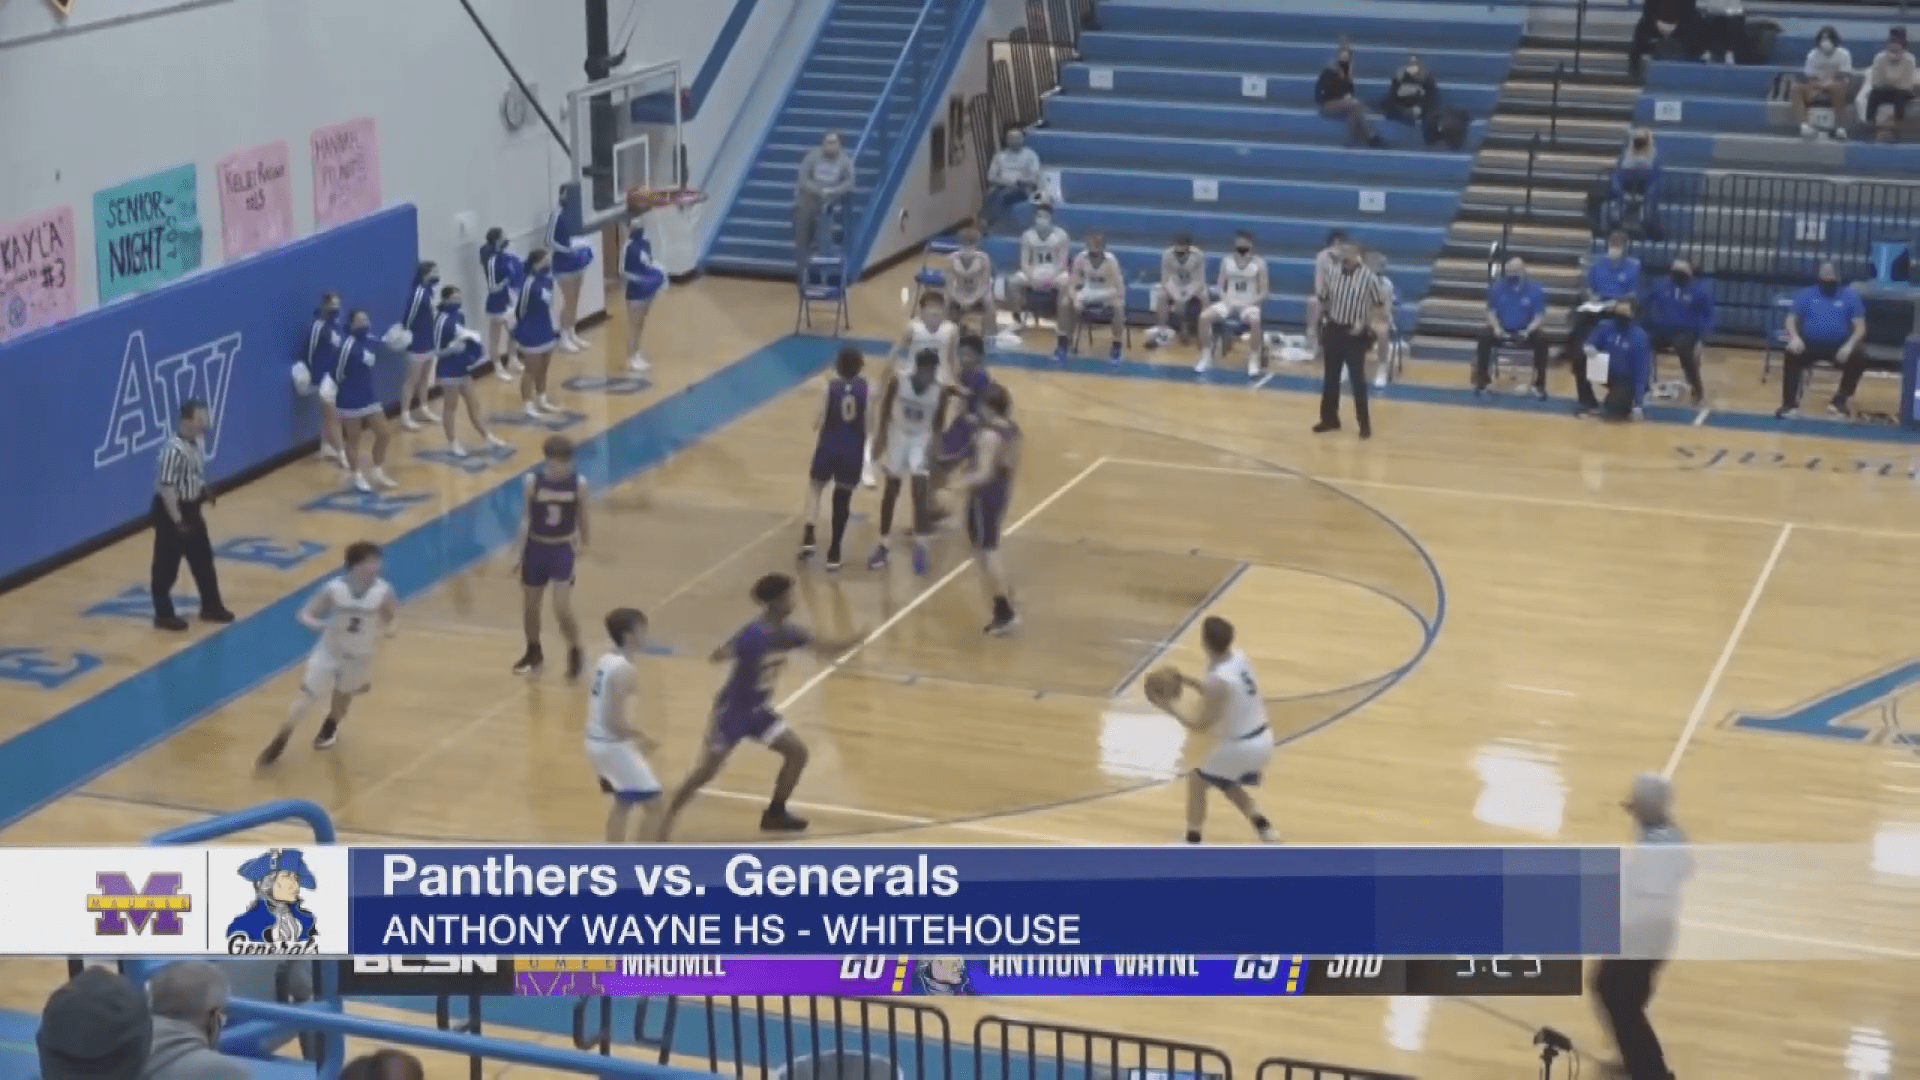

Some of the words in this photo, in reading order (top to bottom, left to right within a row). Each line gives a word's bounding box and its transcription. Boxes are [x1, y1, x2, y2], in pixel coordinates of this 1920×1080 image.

[106, 191, 166, 229] SENIOR
[0, 221, 64, 273] KAYLA
[108, 226, 164, 283] NIGHT
